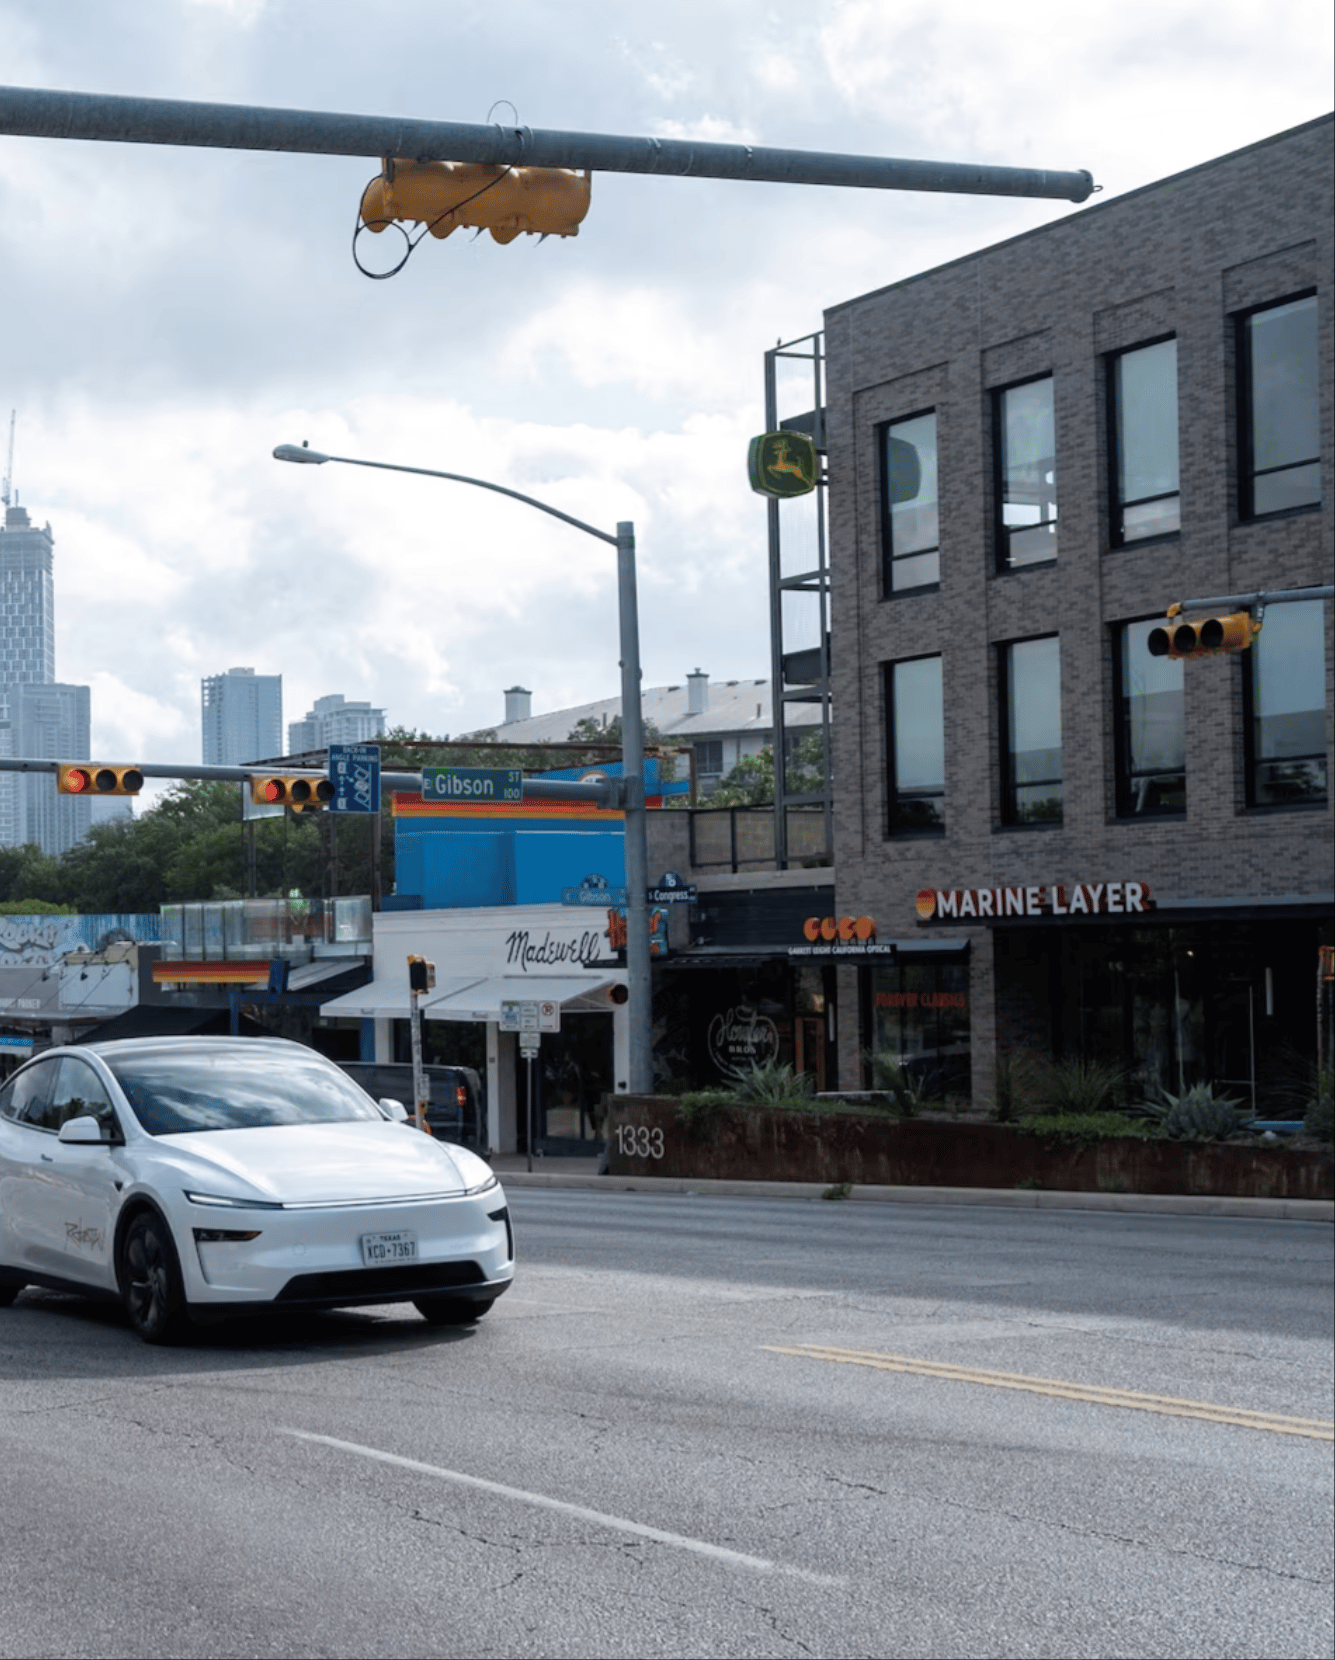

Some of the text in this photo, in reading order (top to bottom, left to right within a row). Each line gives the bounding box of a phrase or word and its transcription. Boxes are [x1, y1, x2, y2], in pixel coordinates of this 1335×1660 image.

[508, 771, 520, 782] ST
[424, 773, 494, 795] E Gibson
[503, 788, 520, 799] 100
[579, 891, 612, 902] Gibson
[654, 889, 689, 902] Congress
[937, 881, 1147, 918] MARINE LAYER
[506, 931, 600, 972] Madewell
[867, 944, 892, 954] OPTICAL
[615, 1124, 665, 1159] 1333
